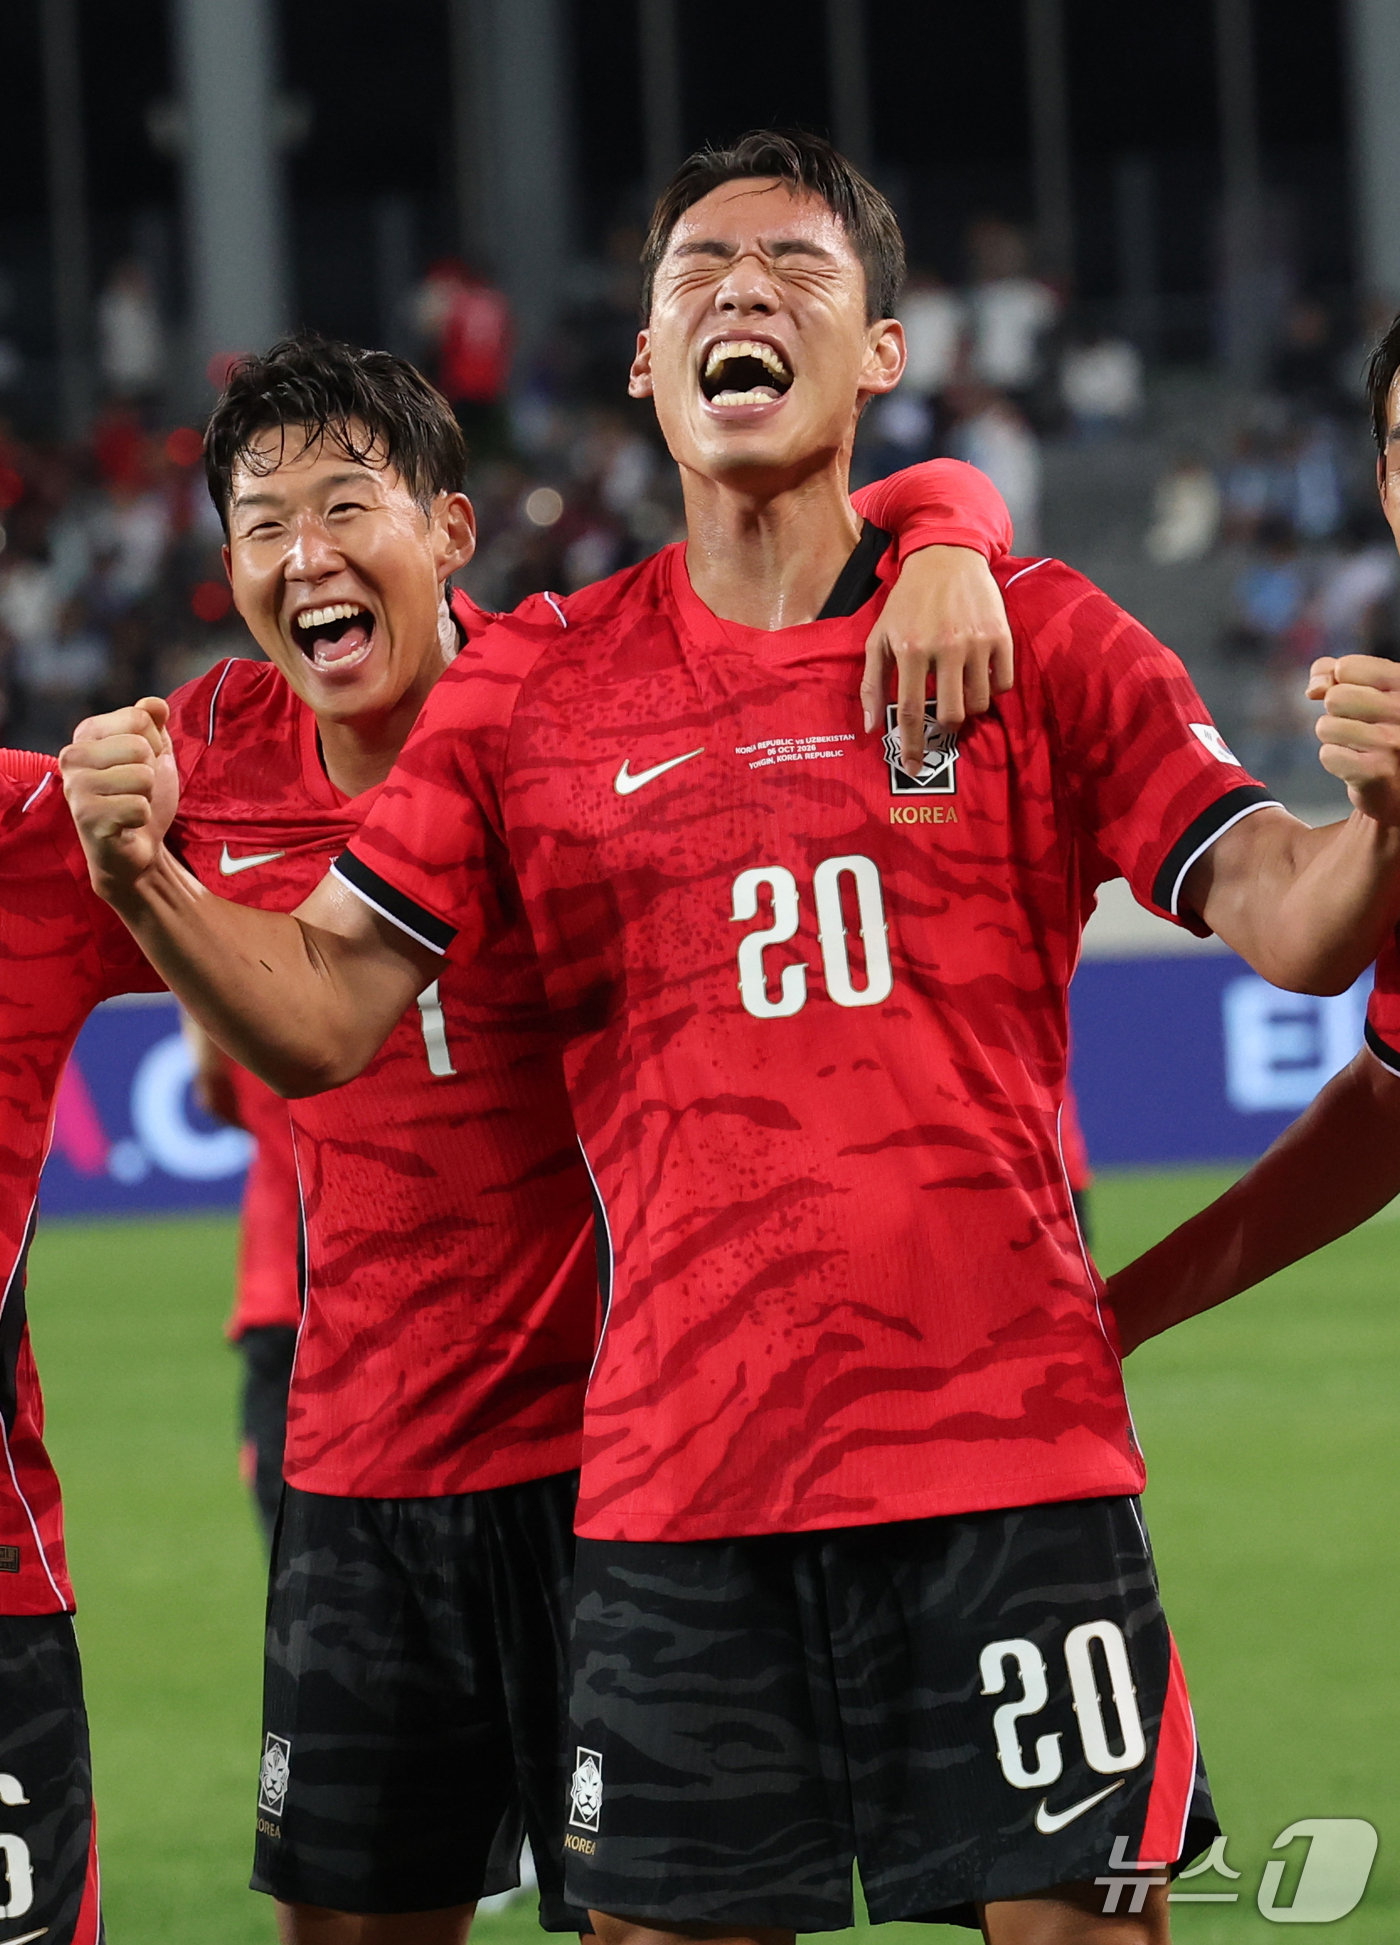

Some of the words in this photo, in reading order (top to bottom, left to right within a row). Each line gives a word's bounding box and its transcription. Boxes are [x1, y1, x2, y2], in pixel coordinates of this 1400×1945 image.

[757, 738, 794, 750] REPUBLIC
[805, 733, 856, 744] UZBEKISTAN
[777, 746, 796, 754] OCT
[797, 744, 817, 753] 2026
[776, 753, 803, 763] KOREA
[804, 749, 844, 760] REPUBLIC
[889, 806, 958, 824] KOREA
[728, 854, 894, 1019] 20
[979, 1620, 1146, 1789] 20
[257, 1817, 281, 1839] OREA
[564, 1833, 596, 1855] KOREA
